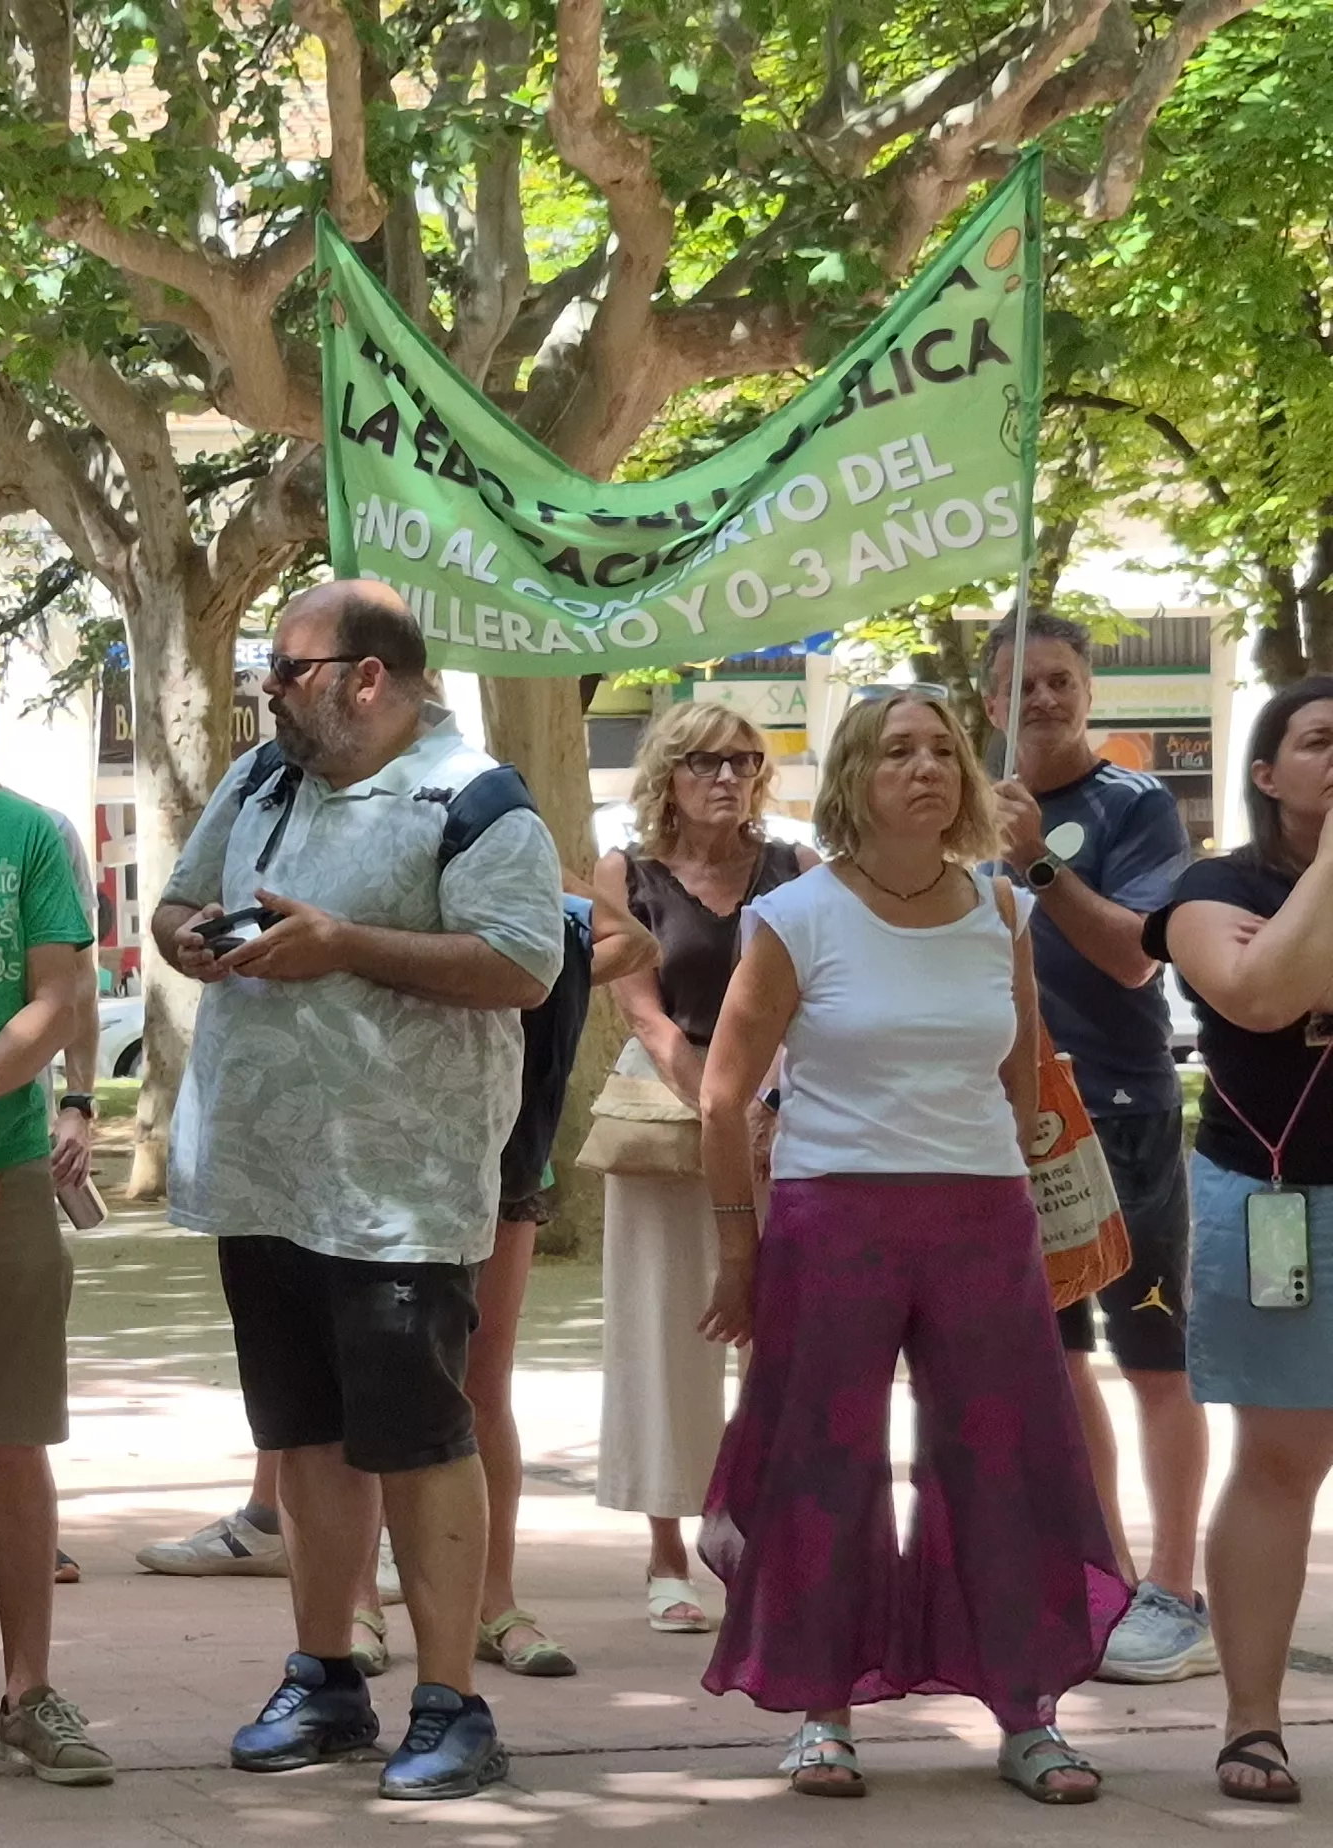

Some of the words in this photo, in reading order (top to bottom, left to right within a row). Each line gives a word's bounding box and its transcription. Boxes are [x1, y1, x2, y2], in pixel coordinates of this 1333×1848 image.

[341, 381, 399, 458] LA
[748, 316, 1012, 481] BLICA
[353, 493, 431, 561] ¡NO
[437, 527, 499, 585] AL
[512, 472, 830, 621] CONCIERTO
[837, 431, 955, 506] DEL
[664, 583, 710, 636] Y
[724, 548, 832, 620] 0-3
[115, 704, 133, 741] B
[1043, 1180, 1074, 1198] AND
